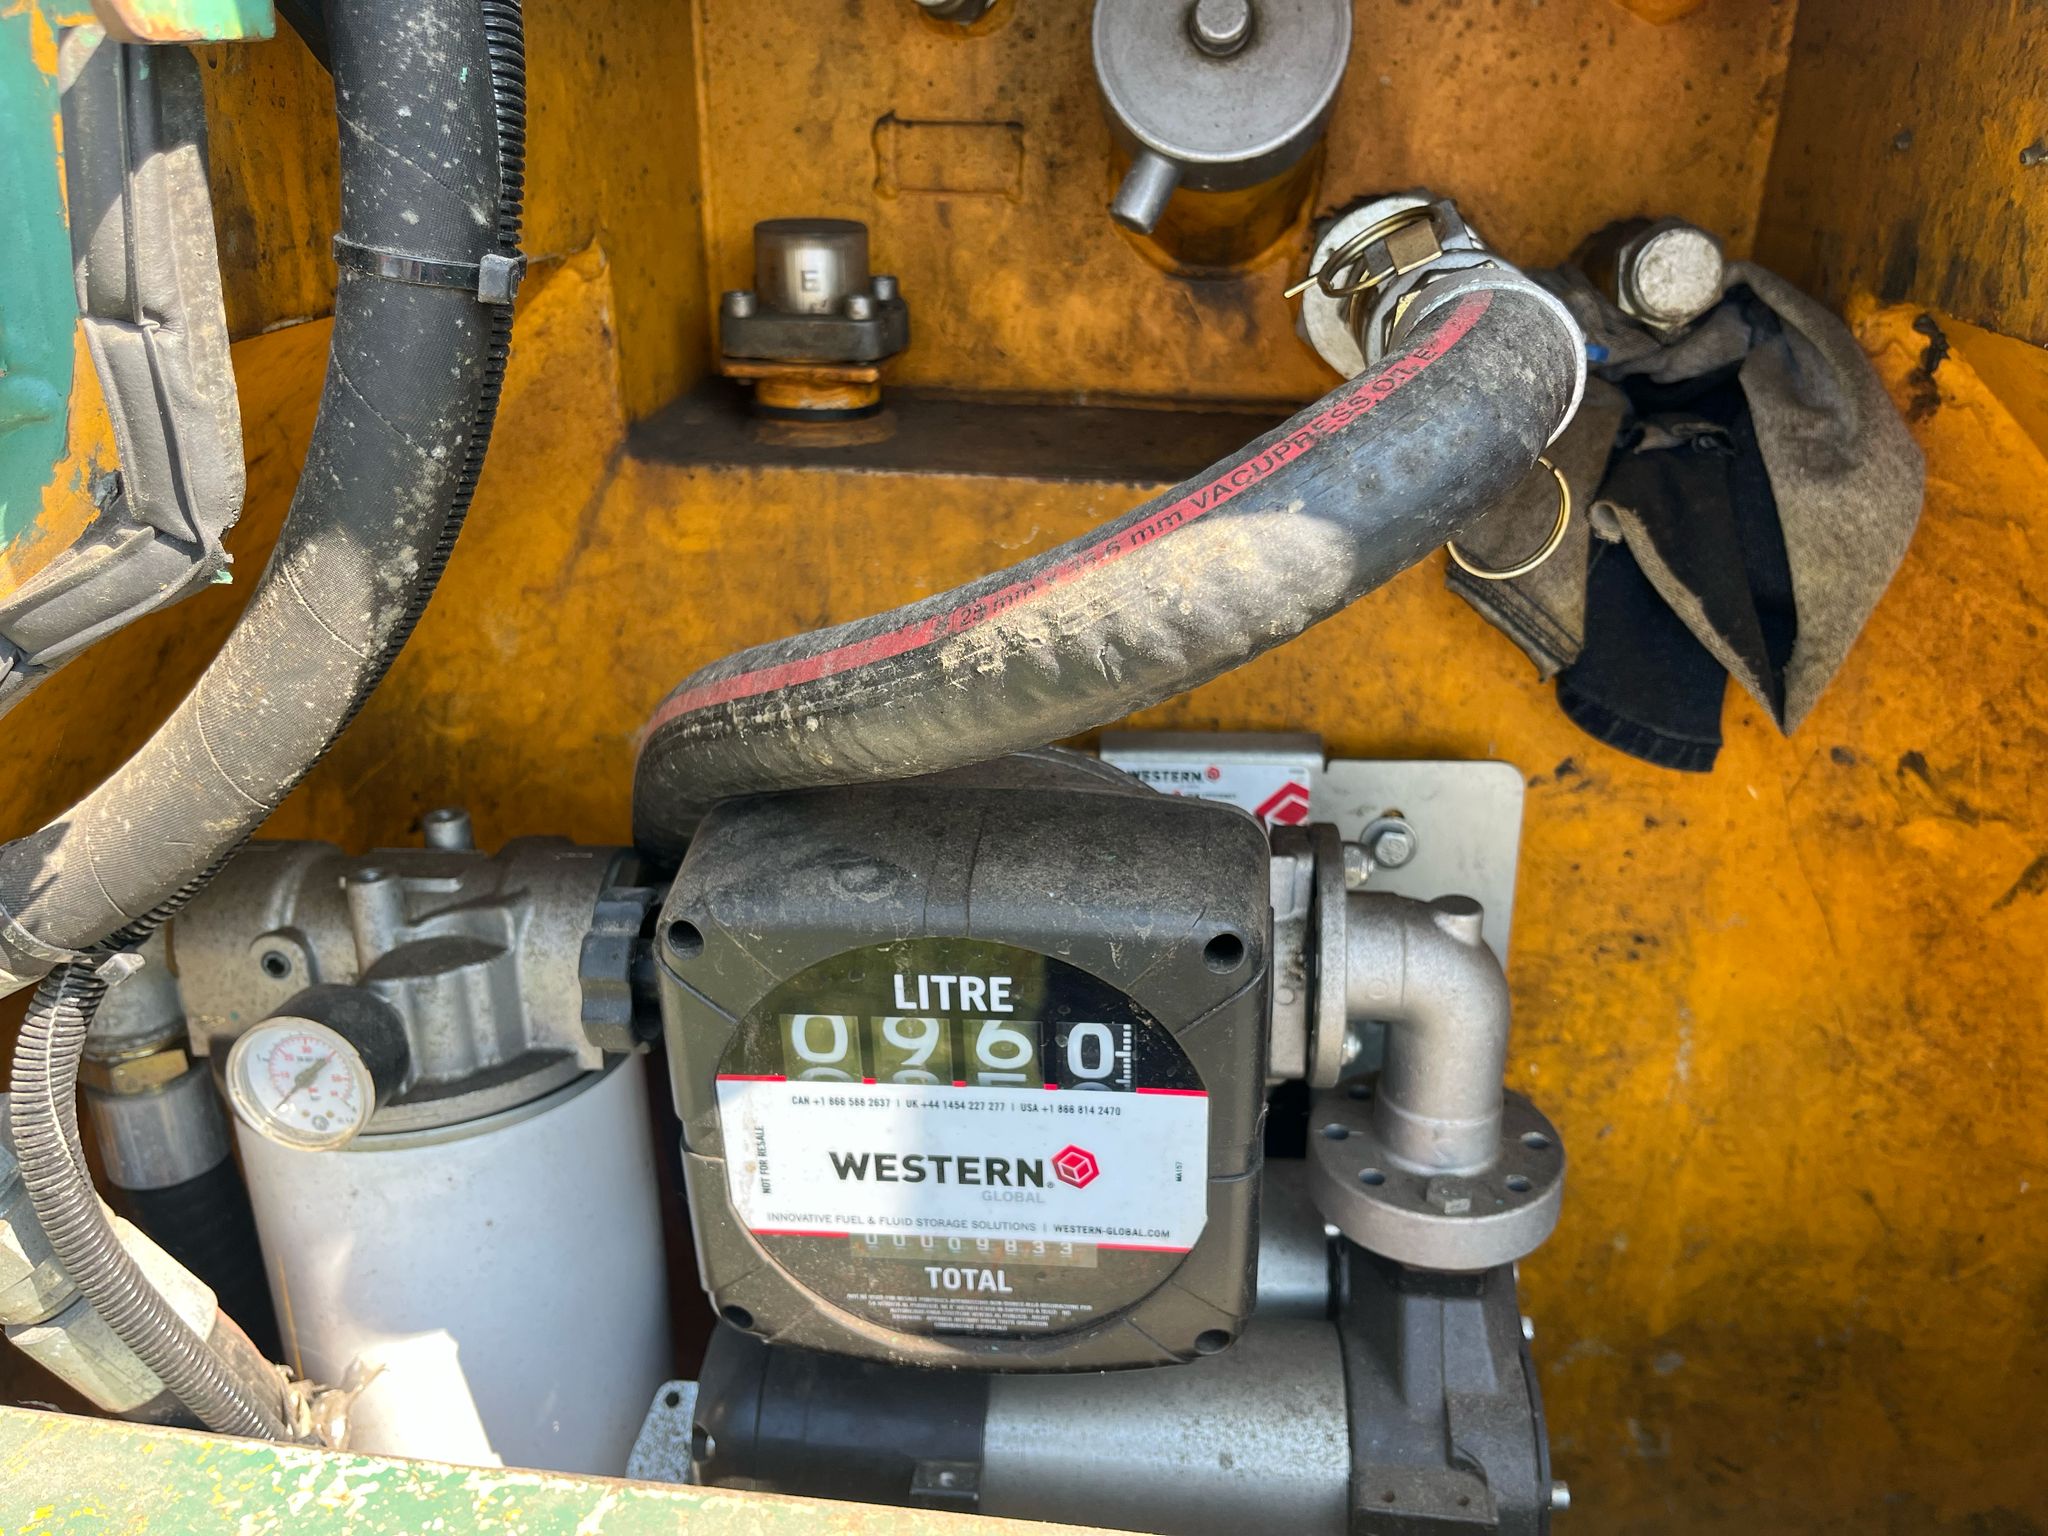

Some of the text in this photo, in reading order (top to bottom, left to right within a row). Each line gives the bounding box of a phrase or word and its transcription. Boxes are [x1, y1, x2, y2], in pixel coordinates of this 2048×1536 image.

[801, 270, 820, 291] E
[1130, 510, 1183, 545] mm
[1189, 393, 1371, 510] VACUPRESS
[893, 974, 1014, 1012] LITRE
[792, 1096, 810, 1105] CAN
[813, 1097, 825, 1106] +1
[869, 1098, 891, 1108] 2637
[906, 1099, 919, 1108] UK
[921, 1100, 940, 1109] +44
[943, 1100, 965, 1110] 1454
[968, 1101, 985, 1111] 227
[988, 1102, 1005, 1111] 277
[1020, 1103, 1039, 1112] USA
[1041, 1104, 1054, 1113] +1
[1078, 1105, 1095, 1114] 814
[1098, 1106, 1121, 1116] 2470
[754, 1125, 771, 1194] NOT FOR RESALE
[829, 1151, 1044, 1188] WESTERN
[982, 1190, 1045, 1204] GLOBAL
[767, 1212, 1037, 1232] INNOVATIVE FUEL & FLUID STORAGE SOLUTIONS
[1053, 1223, 1171, 1238] WESTERN-GLOBAL.COM
[924, 1266, 1014, 1293] TOTAL
